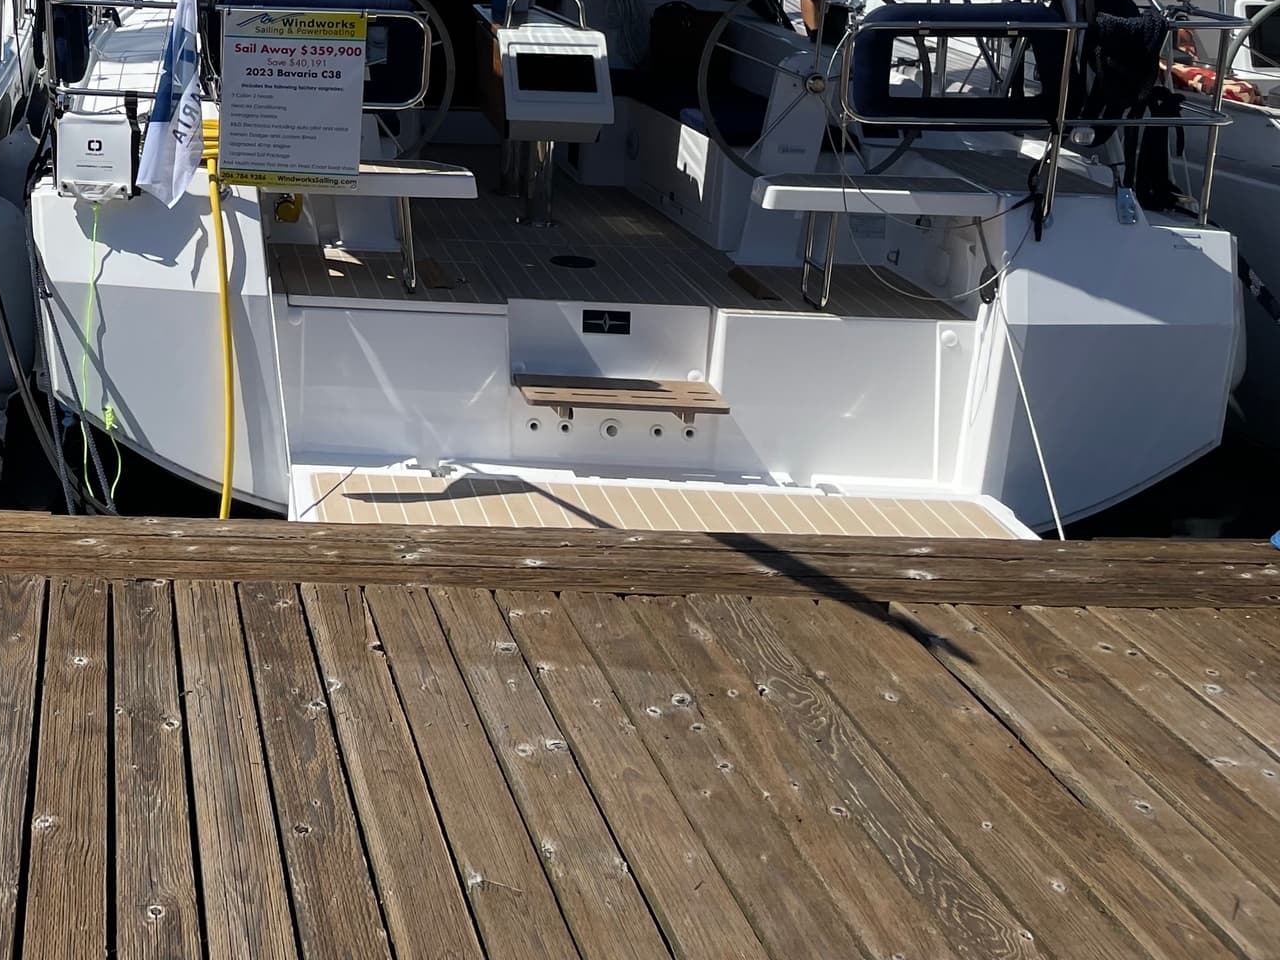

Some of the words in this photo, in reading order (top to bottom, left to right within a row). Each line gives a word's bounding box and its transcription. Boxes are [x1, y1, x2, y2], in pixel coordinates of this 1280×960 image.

[282, 18, 356, 29] Windworks
[255, 26, 284, 35] Sailing
[296, 27, 356, 38] Powerboating
[234, 43, 256, 54] Sail
[260, 44, 297, 57] Away
[267, 58, 287, 67] Save
[246, 67, 274, 77] 2023
[277, 68, 318, 78] Bavaria
[321, 70, 341, 80] C38
